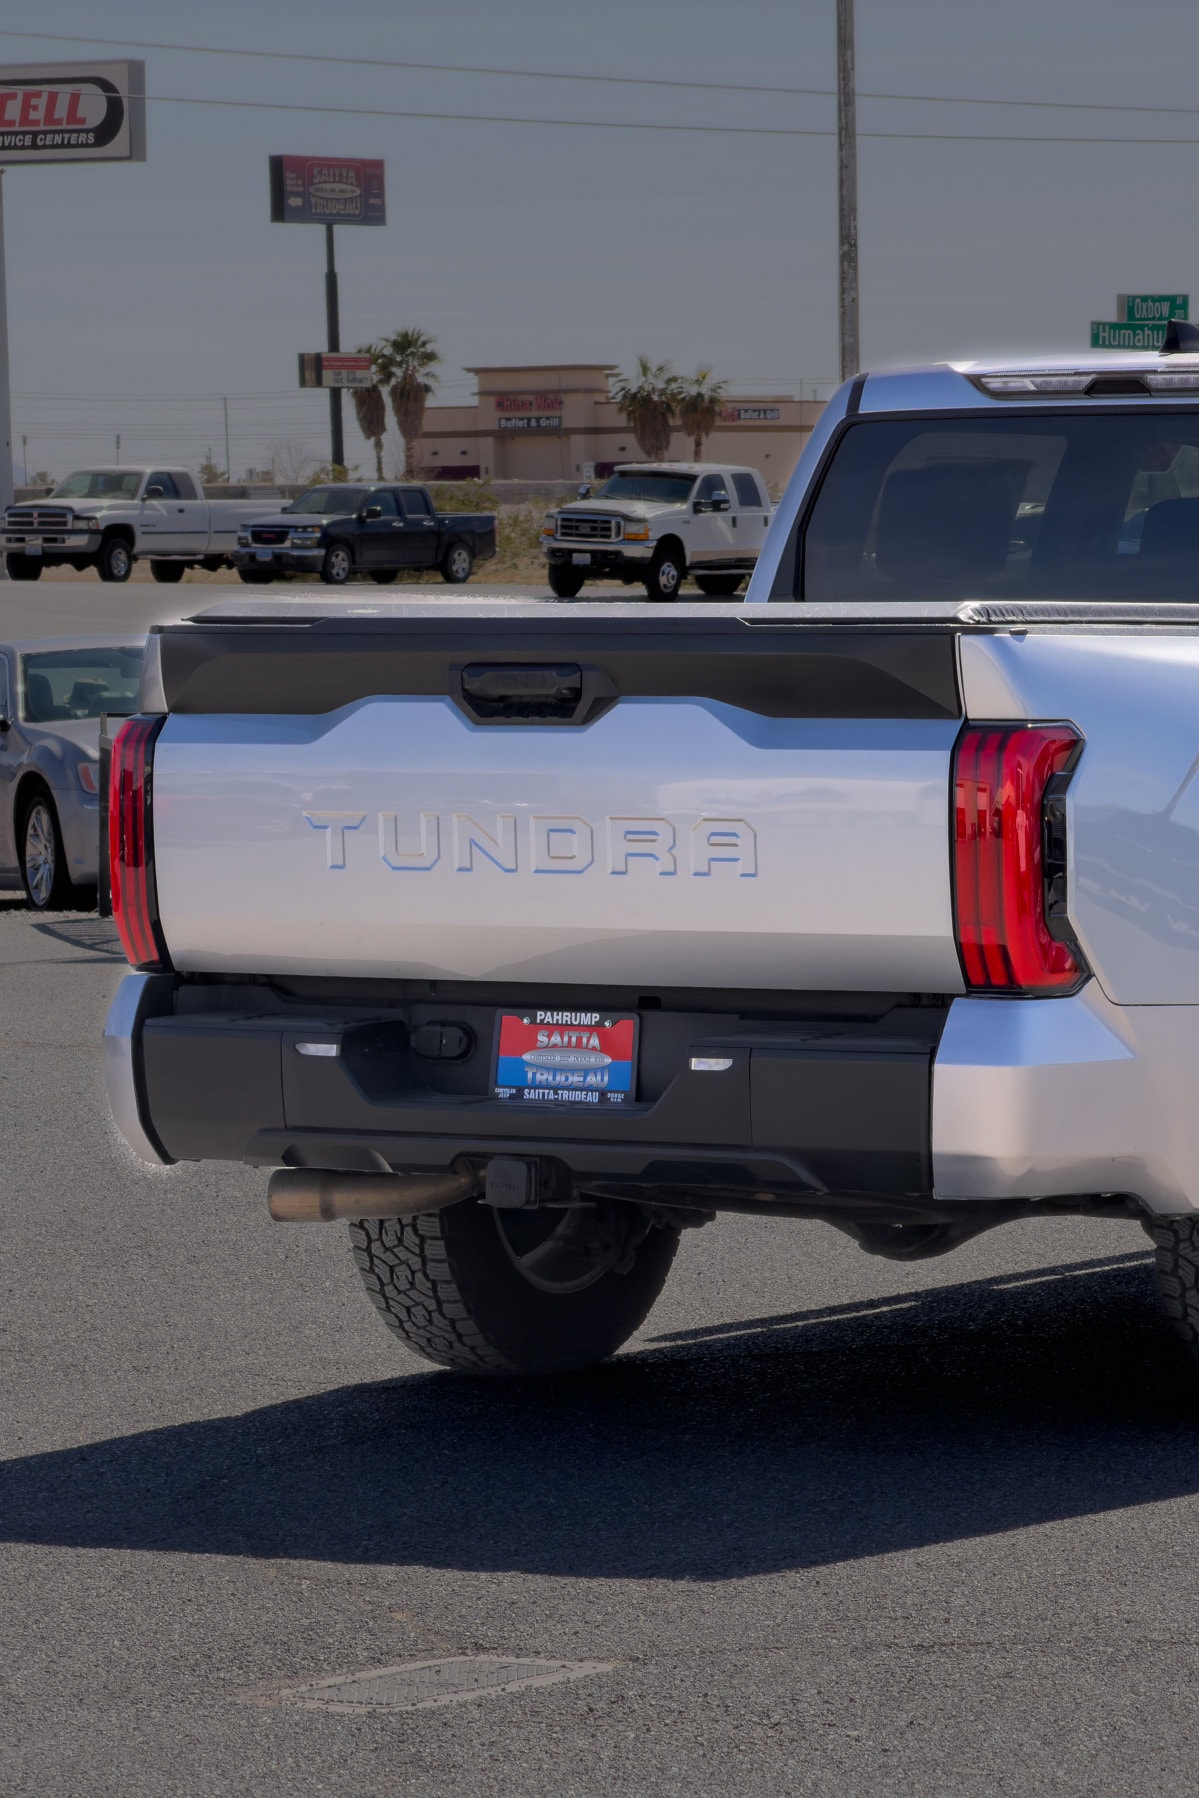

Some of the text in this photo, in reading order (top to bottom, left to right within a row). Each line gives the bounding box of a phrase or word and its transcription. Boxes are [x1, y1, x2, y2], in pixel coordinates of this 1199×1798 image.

[37, 133, 95, 145] CENTERS
[311, 197, 360, 214] TRUDEAU
[1134, 298, 1170, 318] Oxbow
[1099, 325, 1163, 347] Humahu
[496, 395, 560, 412] China Wok
[500, 417, 560, 427] Buffet & Grill
[302, 810, 757, 877] TUNDRA
[536, 1011, 600, 1025] PAHRUMP
[536, 1030, 600, 1050] SAITTA
[524, 1066, 609, 1088] TRUDEAU
[524, 1089, 599, 1103] SAITTA-TRUDEAU
